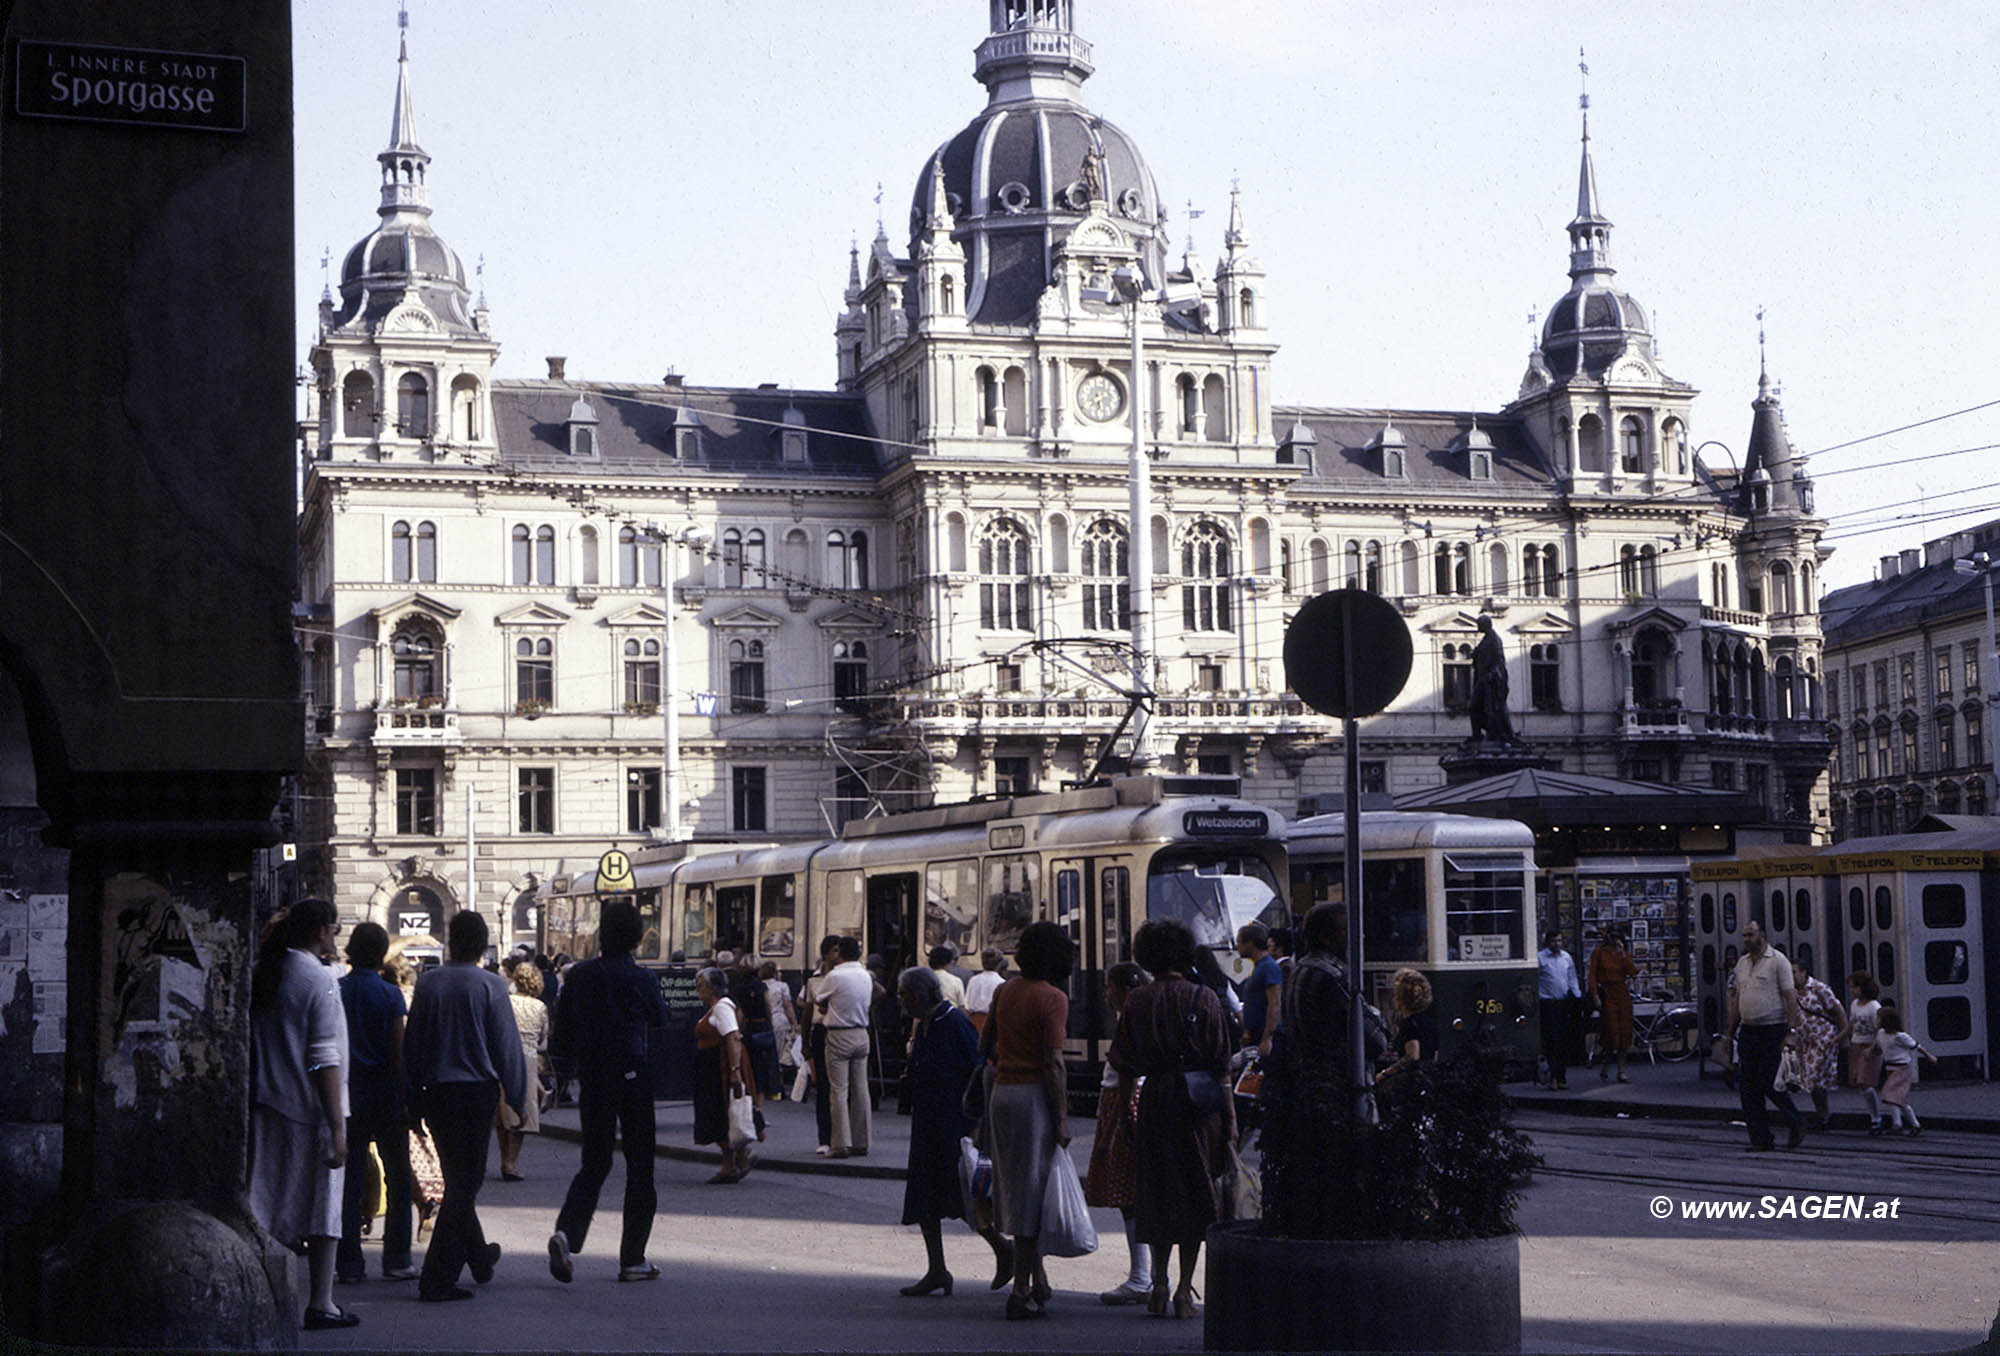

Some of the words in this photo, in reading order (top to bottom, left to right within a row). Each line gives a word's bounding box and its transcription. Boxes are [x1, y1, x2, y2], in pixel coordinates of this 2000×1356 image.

[70, 55, 149, 75] INNERE
[160, 62, 218, 81] STADT
[50, 71, 216, 113] Sporgasse
[1196, 815, 1262, 829] Wetzelsdorf
[608, 856, 622, 875] H
[1925, 855, 1980, 866] TELEFON
[1464, 939, 1473, 955] 5
